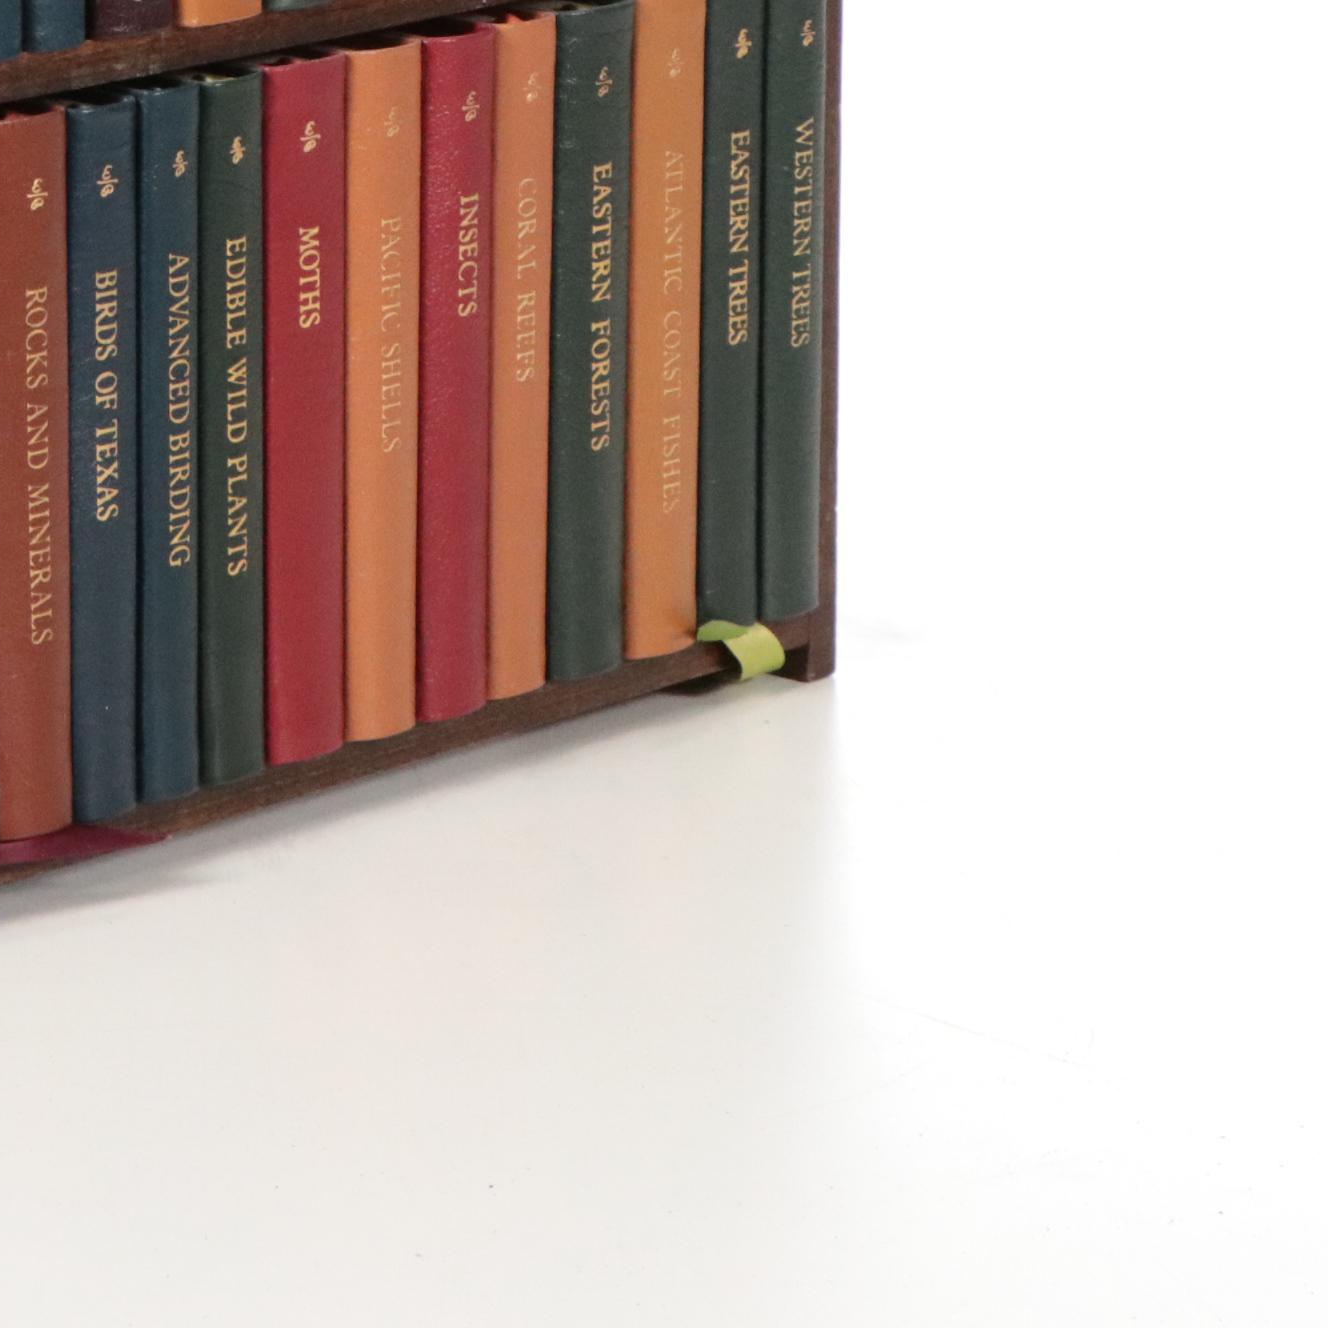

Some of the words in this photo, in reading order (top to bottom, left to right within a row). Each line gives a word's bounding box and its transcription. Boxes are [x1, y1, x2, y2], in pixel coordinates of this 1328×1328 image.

[516, 178, 537, 281] CORAL
[591, 163, 613, 306] EASTERN
[663, 150, 683, 301] ATLANTIC
[729, 131, 751, 255] EASTERN
[791, 118, 814, 257] WESTERN
[226, 236, 248, 349] EDIBLE
[298, 226, 320, 330] MOTHS
[379, 217, 402, 333] PACIFIC
[459, 193, 479, 318] INSECTS
[728, 260, 748, 346] TREES
[790, 260, 810, 348] TREES
[25, 286, 48, 390] ROCKS
[95, 270, 117, 363] BIRDS
[167, 253, 190, 423] ADVANCED
[516, 291, 535, 384] REEFS
[662, 311, 682, 403] COAST
[26, 402, 49, 469] AND
[95, 372, 118, 411] OF
[227, 357, 248, 444] WILD
[381, 343, 402, 454] SHELLS
[590, 321, 611, 452] FORESTS
[96, 420, 119, 522] TEXAS
[168, 432, 191, 567] BIRDING
[227, 455, 248, 577] PLANTS
[661, 413, 682, 514] FISHES
[28, 484, 52, 646] MINERALS
